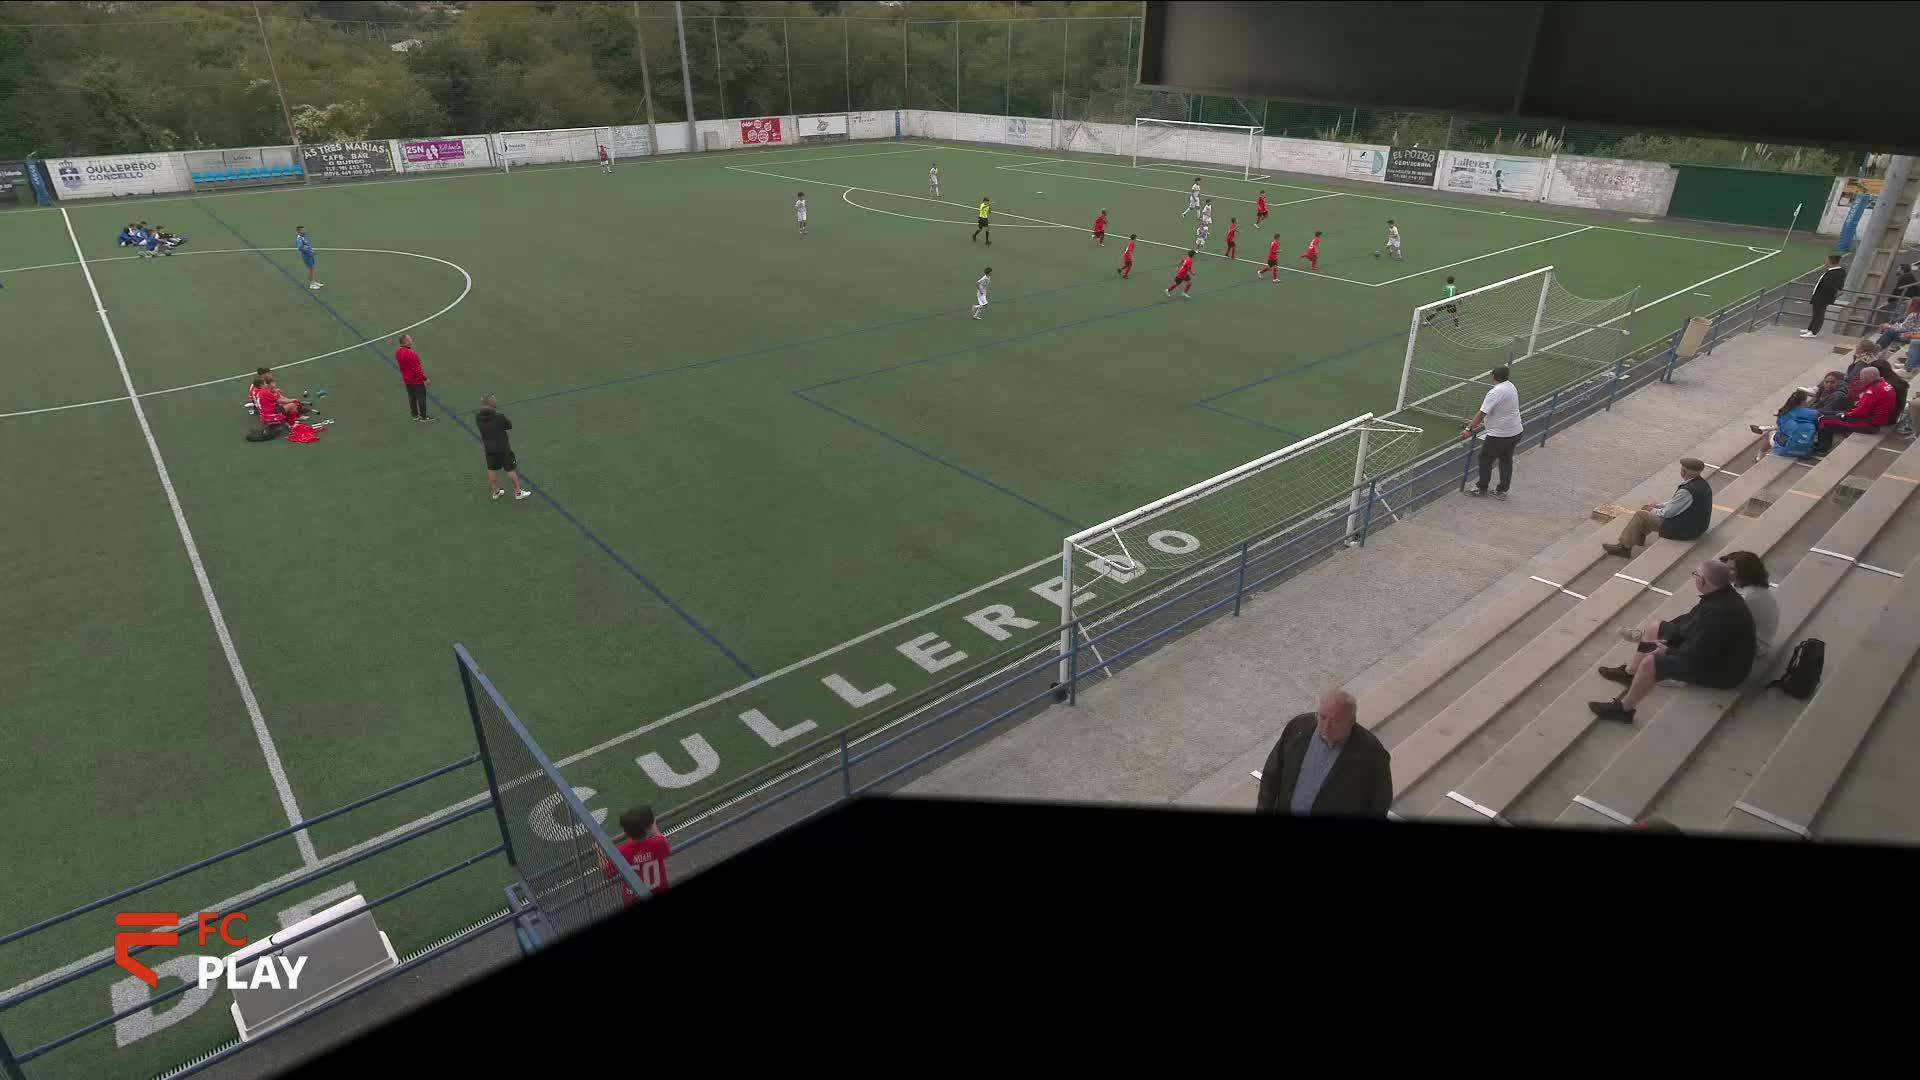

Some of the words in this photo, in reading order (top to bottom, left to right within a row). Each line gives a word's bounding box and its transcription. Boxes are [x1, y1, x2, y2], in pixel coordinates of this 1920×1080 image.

[304, 148, 318, 159] AS
[318, 143, 342, 154] TRES
[345, 142, 385, 154] MARIAS
[406, 145, 424, 154] 25N
[1393, 151, 1404, 160] EL
[1404, 150, 1435, 162] POTRO
[88, 171, 144, 181] CONCELLO
